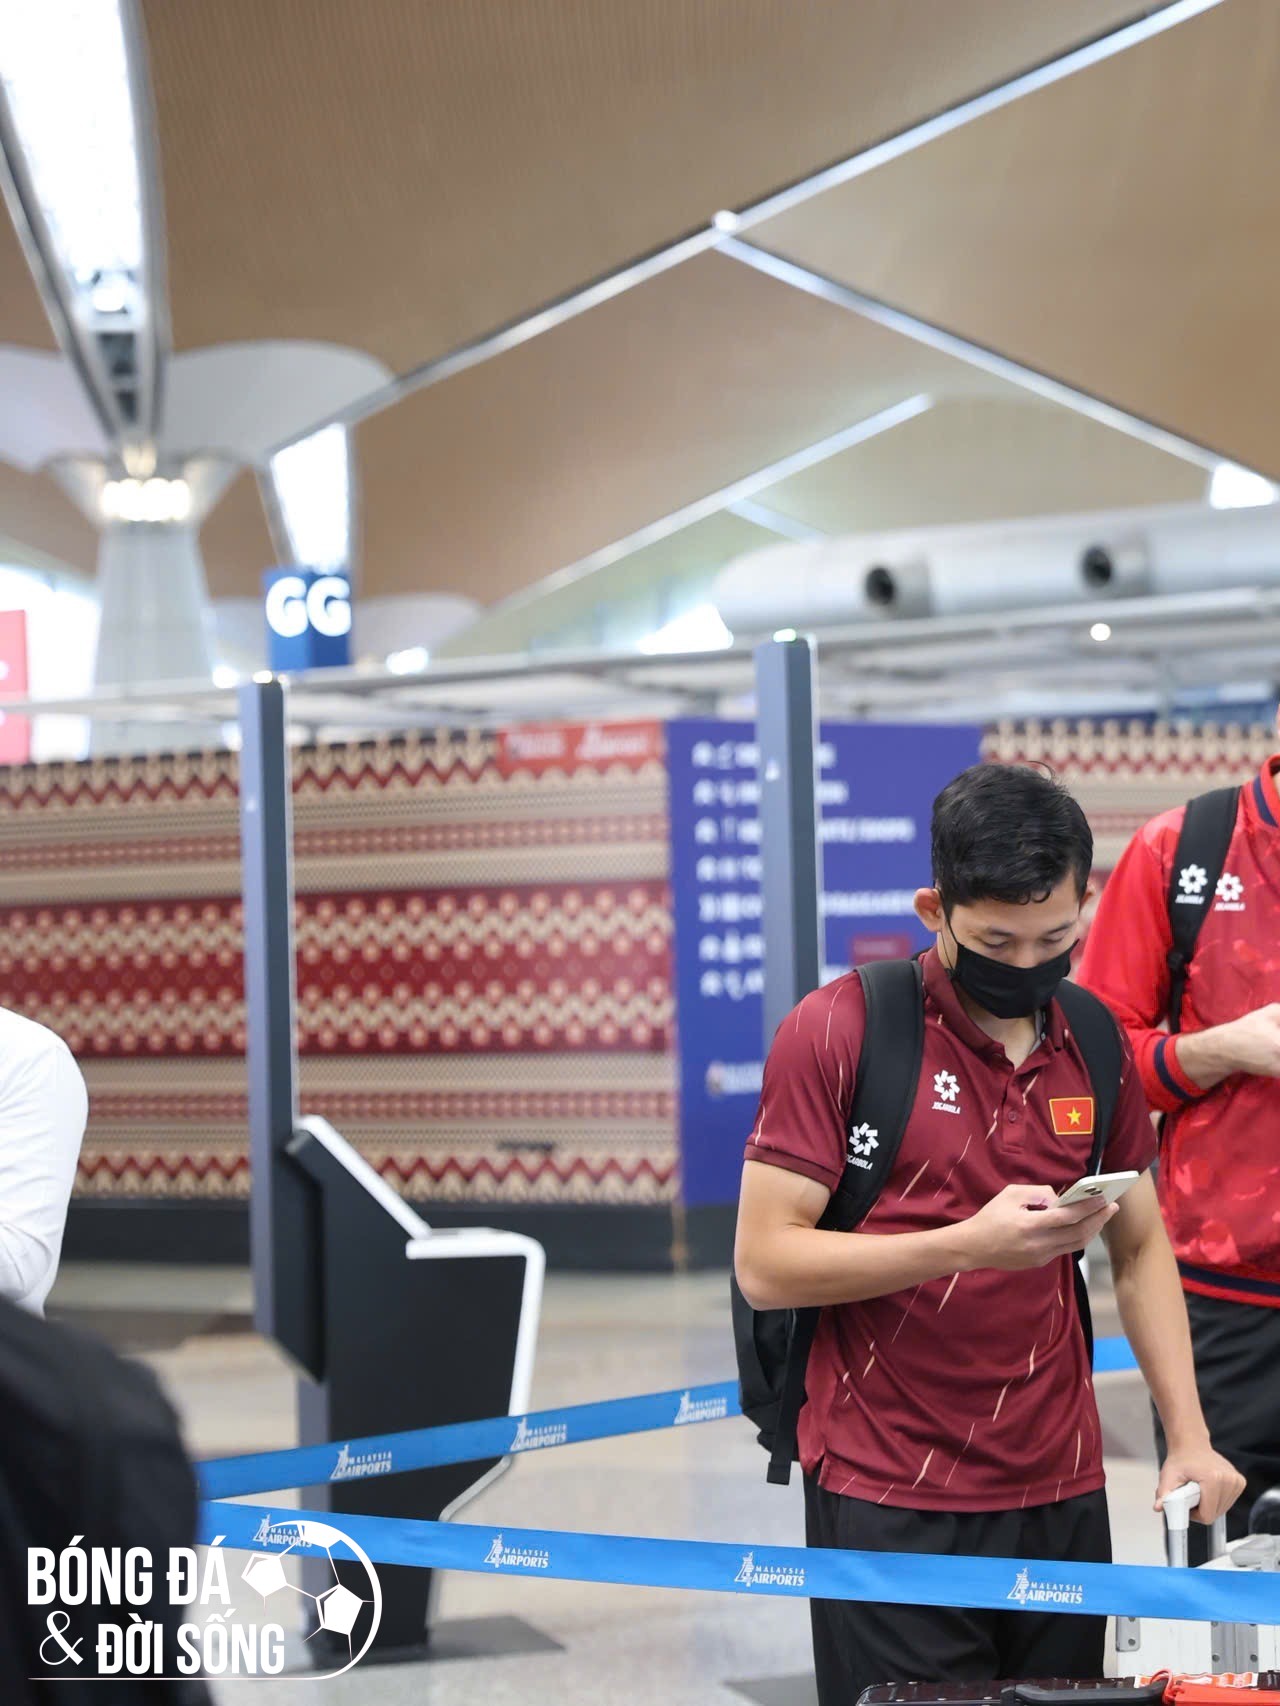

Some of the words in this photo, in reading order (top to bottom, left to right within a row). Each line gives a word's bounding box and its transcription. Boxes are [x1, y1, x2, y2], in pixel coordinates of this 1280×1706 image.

[503, 1547, 549, 1558] MALAYSIA
[500, 1554, 549, 1569] AIRPORTS
[755, 1565, 806, 1576] MALAYSIA
[752, 1573, 805, 1587] AIRPORTS
[1030, 1581, 1083, 1593] MALAYSIA
[1026, 1589, 1083, 1604] AIRPORTS
